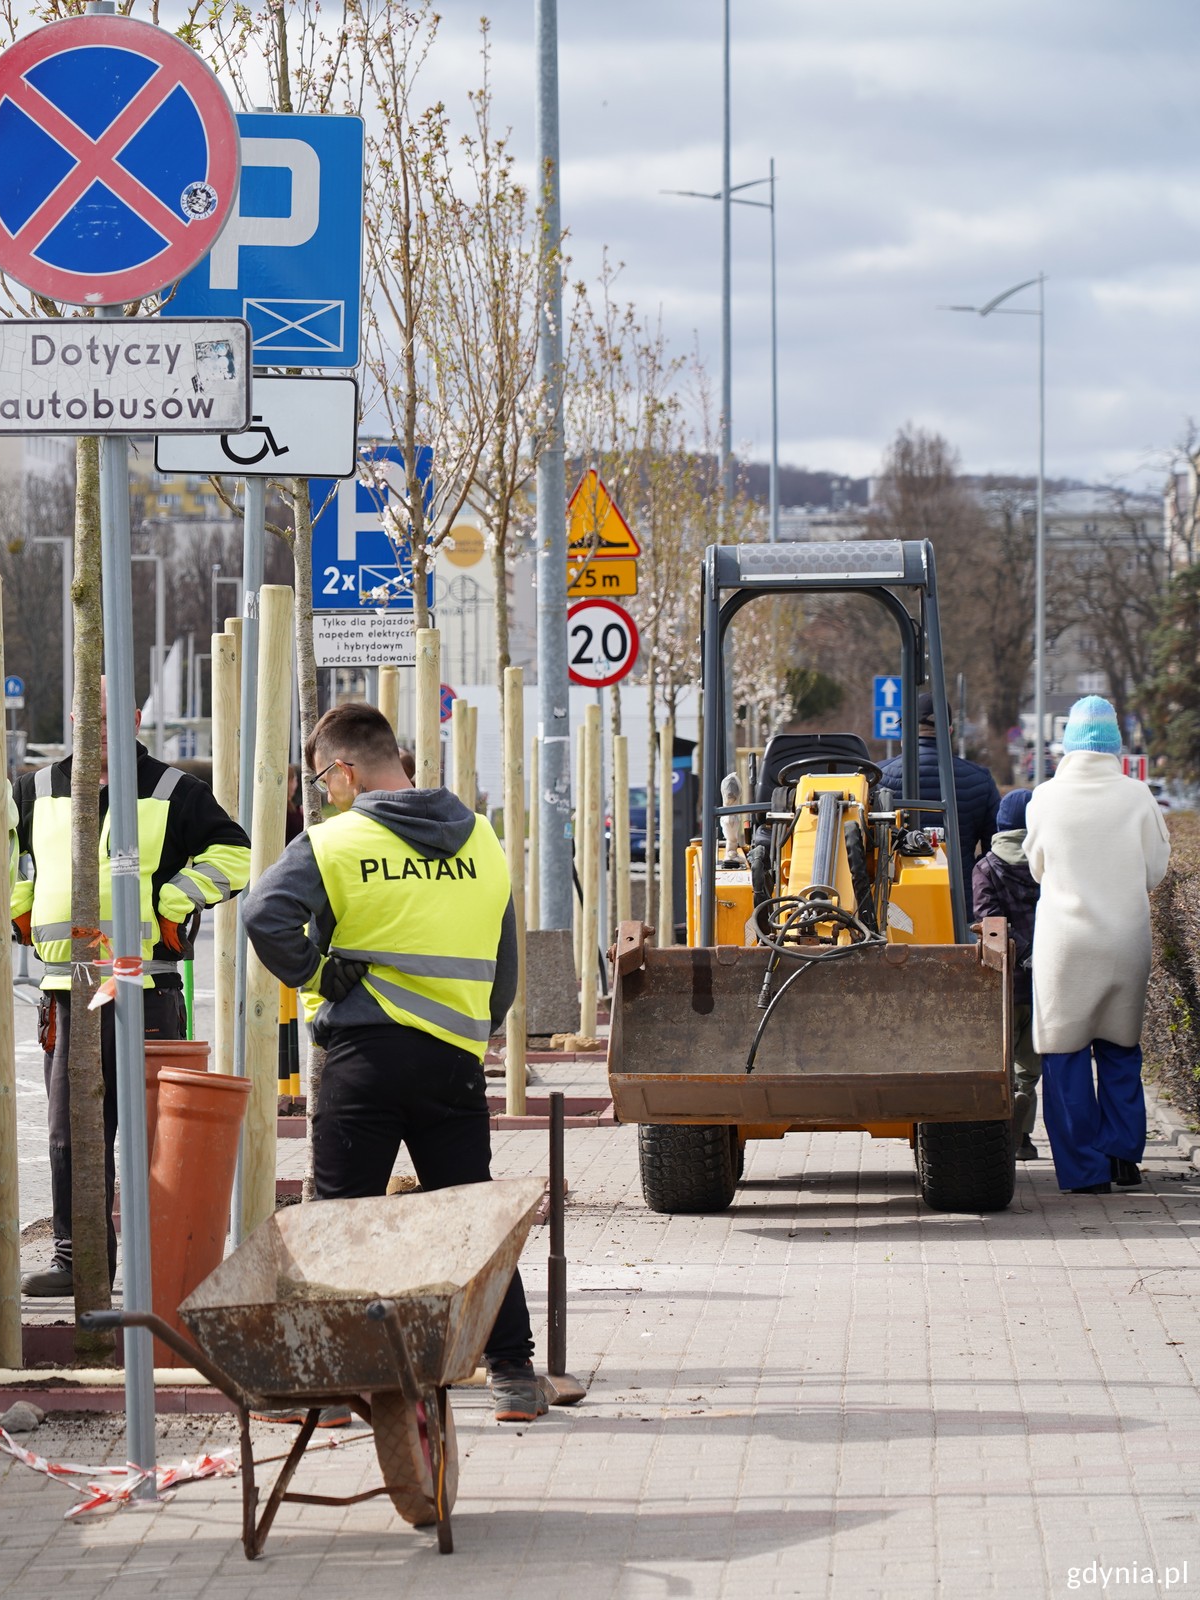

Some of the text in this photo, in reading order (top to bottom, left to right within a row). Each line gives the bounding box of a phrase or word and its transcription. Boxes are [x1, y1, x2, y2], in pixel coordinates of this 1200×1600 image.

[209, 137, 320, 290] P
[31, 334, 182, 375] Dotyczy
[0, 387, 215, 420] autobusów
[322, 566, 356, 595] 2x
[602, 574, 620, 588] m
[319, 630, 364, 640] napędem
[322, 617, 347, 628] Tylko
[350, 617, 366, 626] dla
[344, 641, 403, 652] hybrydowym
[570, 622, 628, 665] 20
[322, 653, 362, 665] podczas
[360, 857, 477, 883] PLATAN
